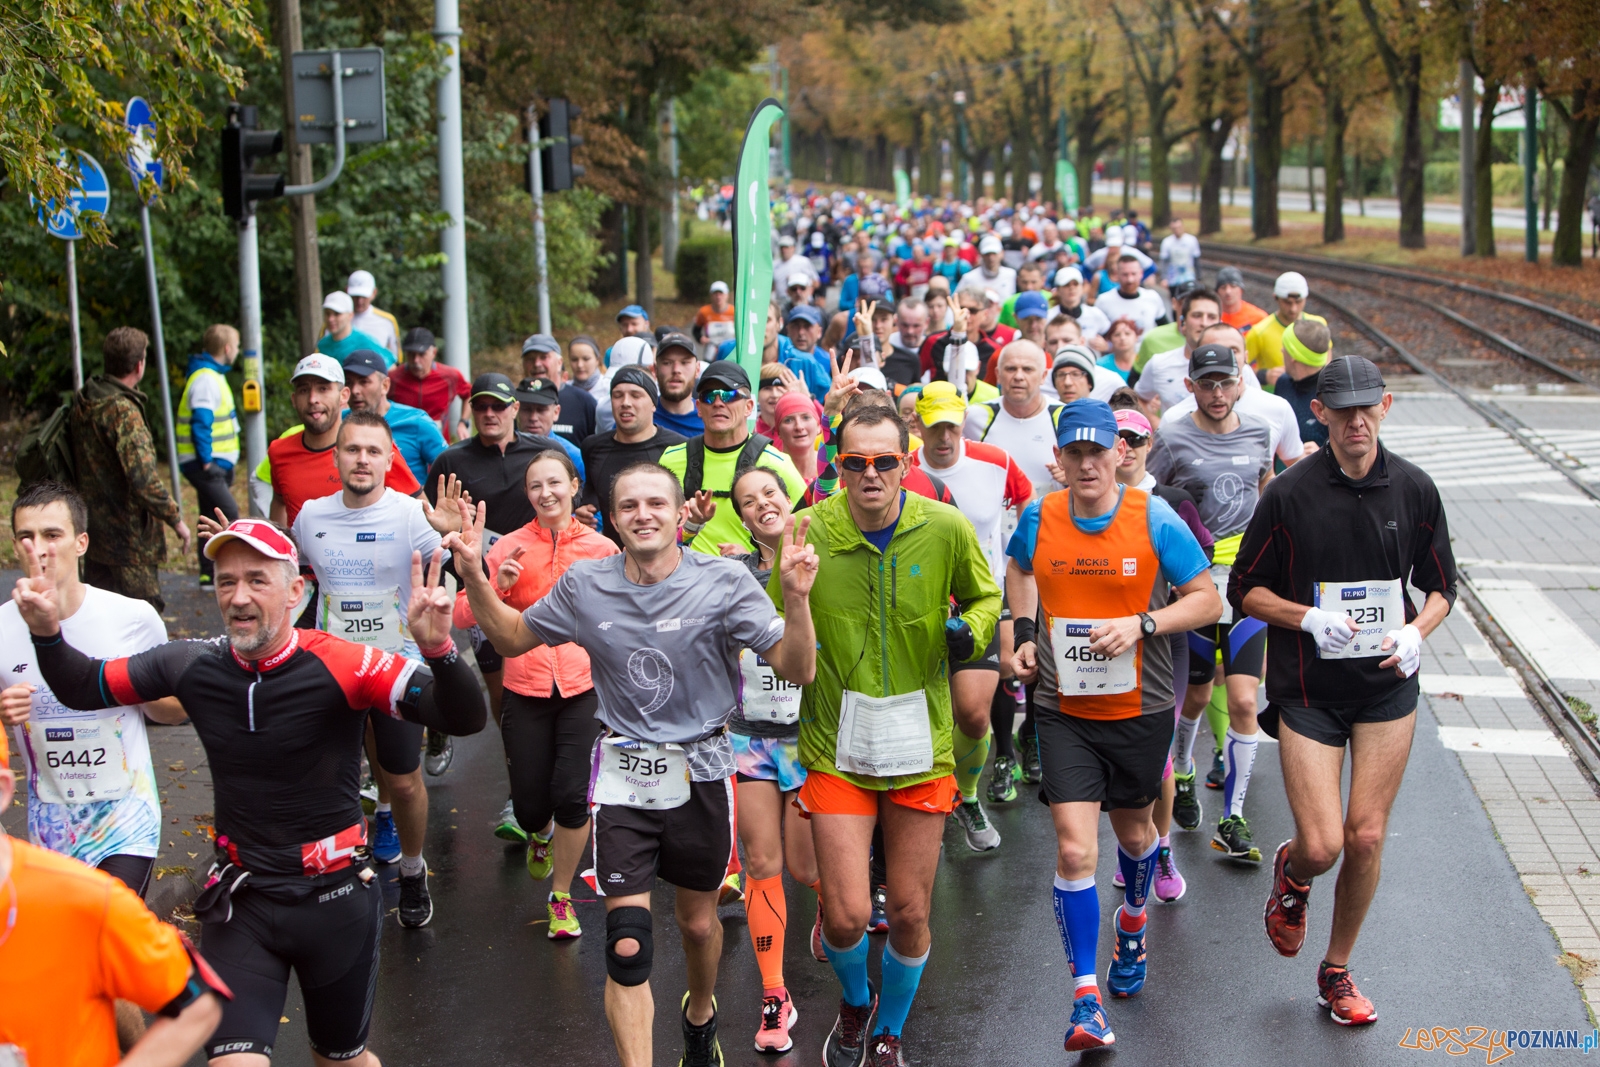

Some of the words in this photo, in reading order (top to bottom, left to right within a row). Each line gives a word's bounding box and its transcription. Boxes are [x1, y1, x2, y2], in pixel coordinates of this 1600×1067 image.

[1213, 472, 1244, 523] 9
[324, 549, 344, 557] SIŁA
[330, 559, 374, 567] ODWAGA
[1076, 558, 1109, 566] MCKiS
[325, 567, 375, 576] SZYBKOŚĆ
[1069, 567, 1117, 576] Jaworzno
[1346, 606, 1385, 624] 1231
[344, 617, 384, 633] 2195
[598, 621, 613, 631] 4F
[12, 663, 28, 674] 4F
[1076, 665, 1108, 674] Andrzej
[626, 646, 675, 715] 9
[32, 684, 52, 695] SIŁ
[770, 695, 793, 703] Arleta
[47, 730, 72, 739] 17.PKO
[46, 748, 106, 768] 6442
[618, 752, 668, 776] 3736
[60, 772, 97, 781] Mateusz
[625, 775, 661, 788] Krzysztof
[330, 883, 354, 900] cep
[225, 1042, 253, 1052] cep
[341, 1045, 365, 1059] cep
